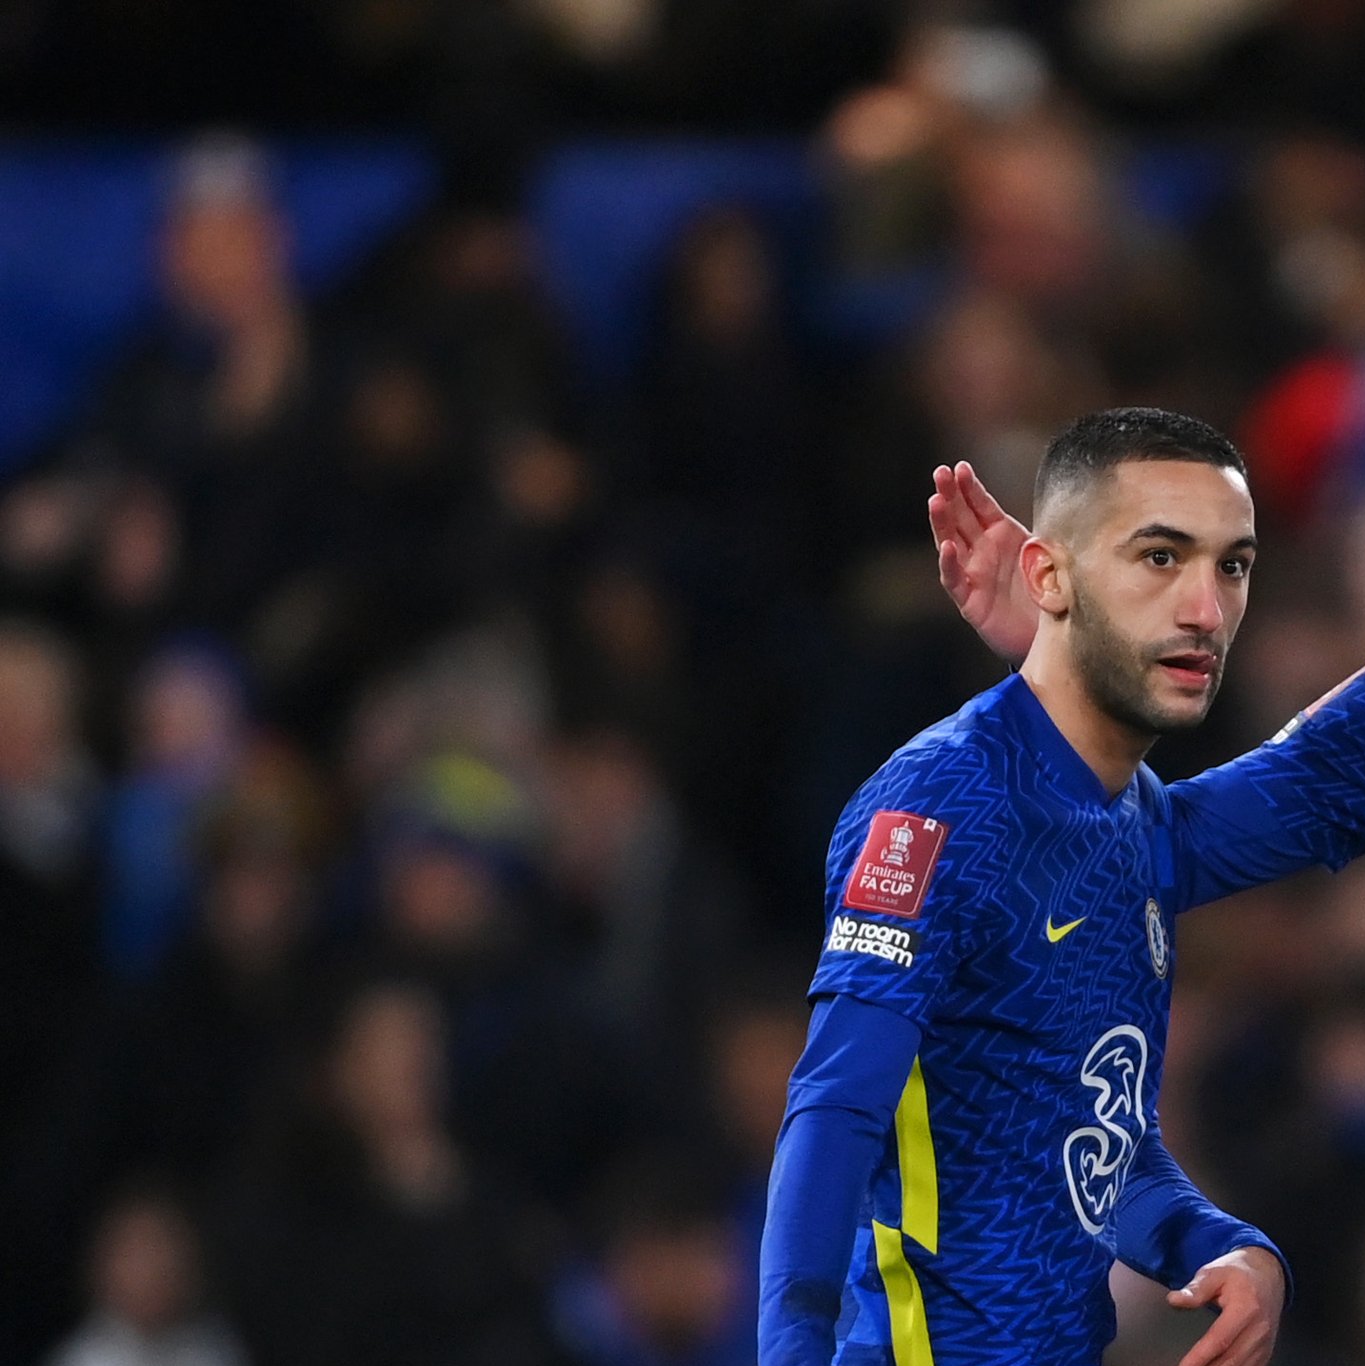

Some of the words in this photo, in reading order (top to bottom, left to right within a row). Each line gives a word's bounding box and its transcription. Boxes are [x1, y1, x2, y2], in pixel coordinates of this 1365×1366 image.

[863, 862, 916, 883] Emirates
[860, 875, 877, 890] FA
[880, 879, 913, 896] CUP
[832, 916, 858, 936] No
[857, 922, 910, 949] room
[850, 938, 914, 968] racism
